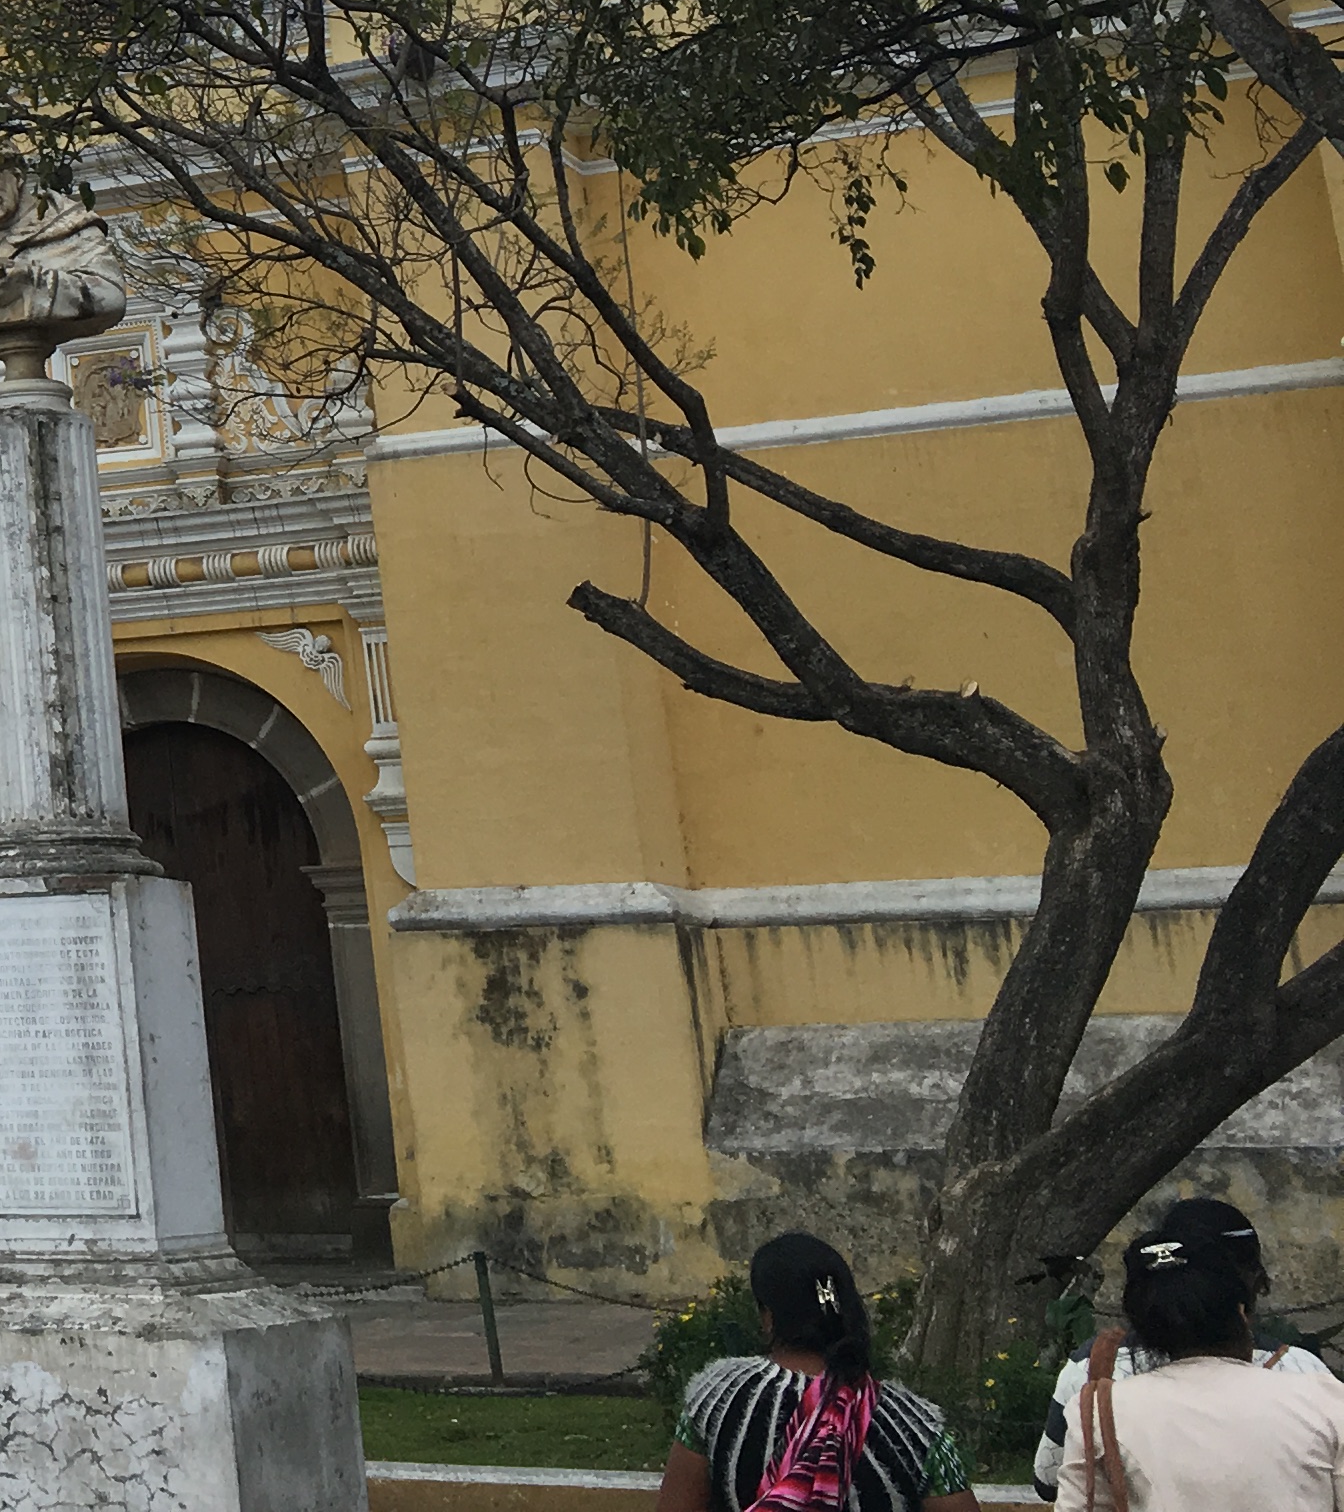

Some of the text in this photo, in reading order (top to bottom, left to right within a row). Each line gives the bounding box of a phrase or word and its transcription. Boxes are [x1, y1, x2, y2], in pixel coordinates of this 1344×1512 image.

[60, 950, 72, 958] DE
[24, 989, 69, 999] ESCRITR
[71, 989, 83, 998] DE
[86, 989, 98, 998] LA
[70, 1136, 81, 1145] DE
[75, 1149, 87, 1159] DE
[80, 1163, 121, 1172] NUESTRA
[5, 1190, 10, 1200] A
[75, 1190, 86, 1200] DE
[89, 1190, 114, 1200] EDAD
